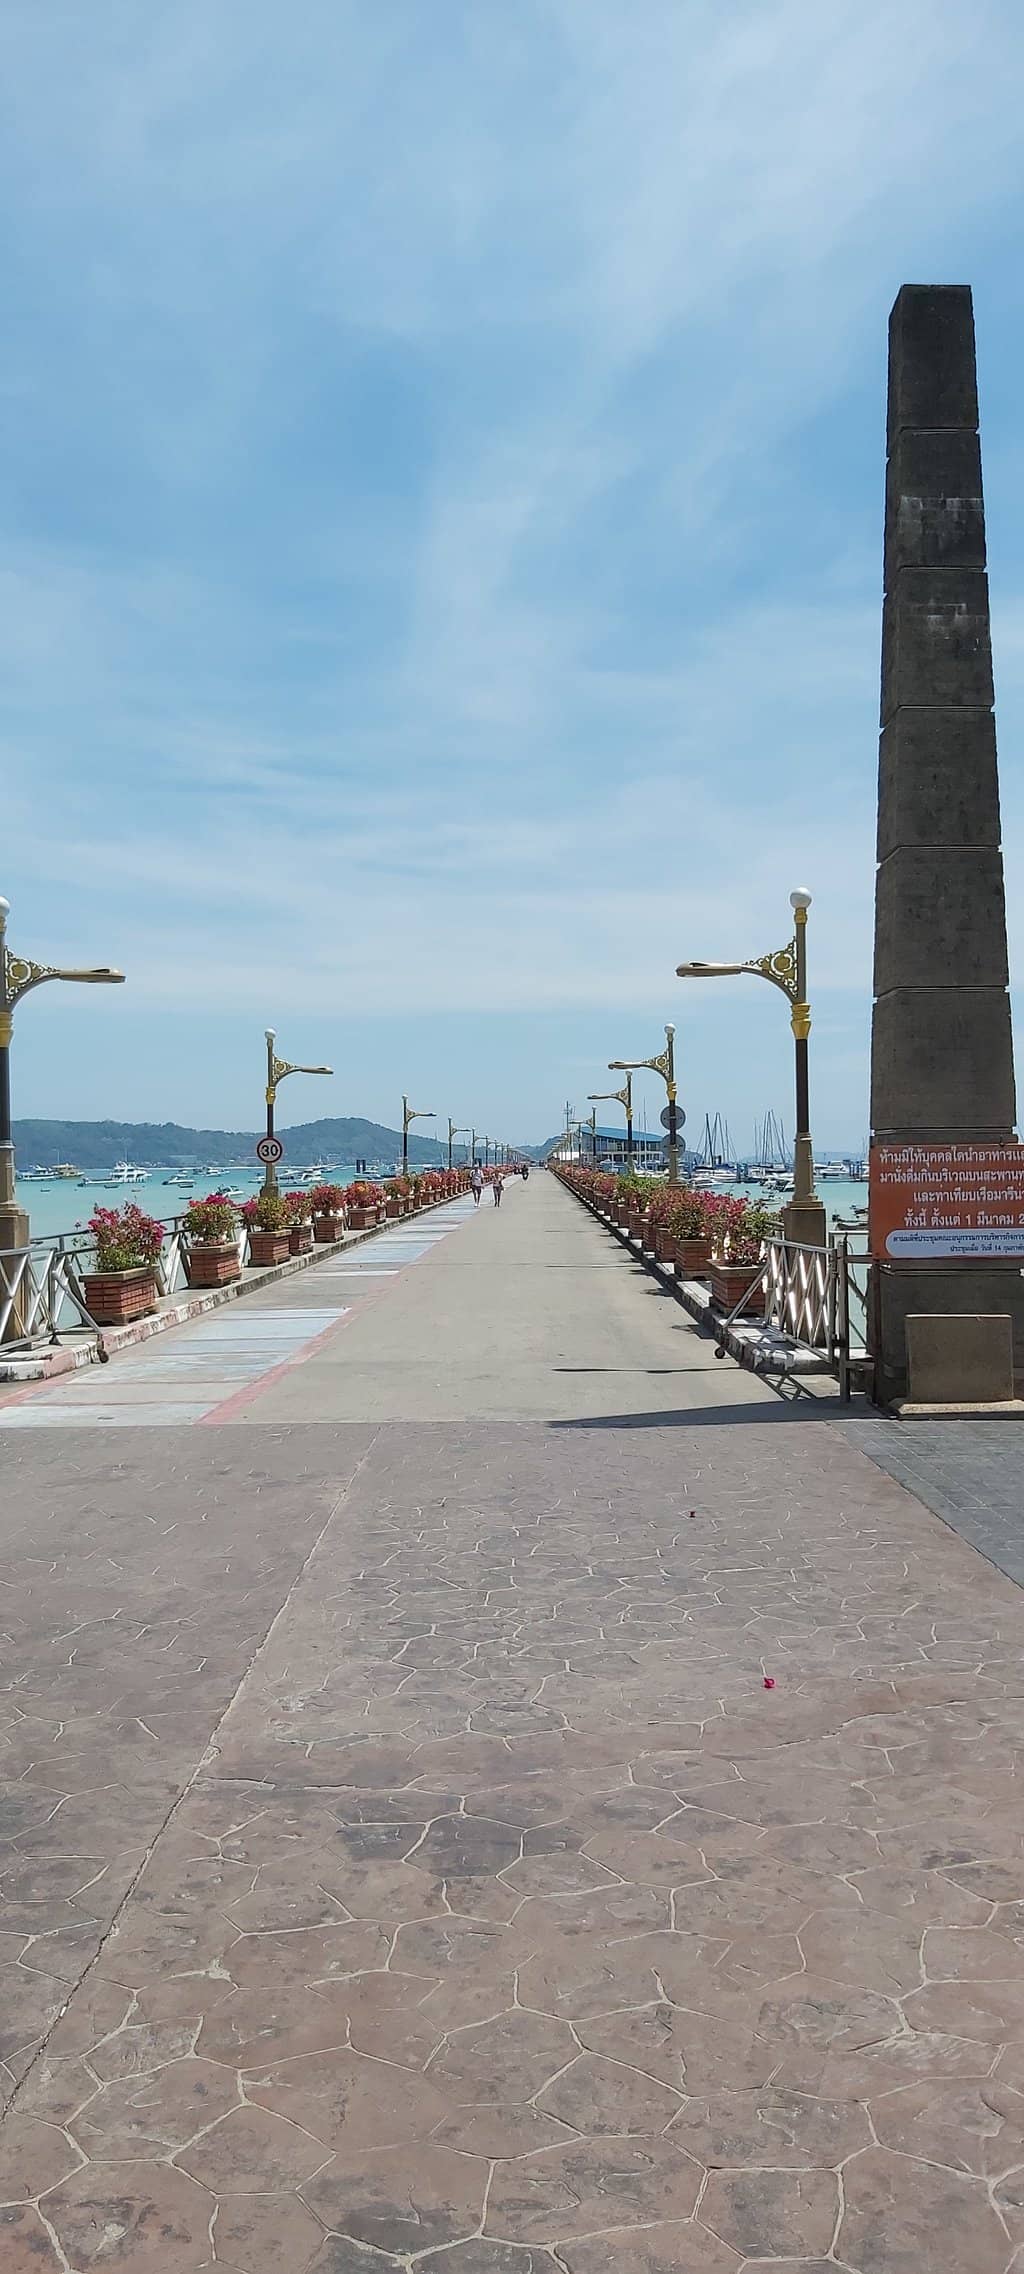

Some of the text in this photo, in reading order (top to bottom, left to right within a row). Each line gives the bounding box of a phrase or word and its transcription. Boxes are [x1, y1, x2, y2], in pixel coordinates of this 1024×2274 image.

[261, 1144, 278, 1156] 30
[904, 1208, 927, 1226] ทั้งนี้
[931, 1207, 960, 1226] ตั้งแต่
[966, 1215, 971, 1225] 1
[977, 1211, 1014, 1225] มีนาคม
